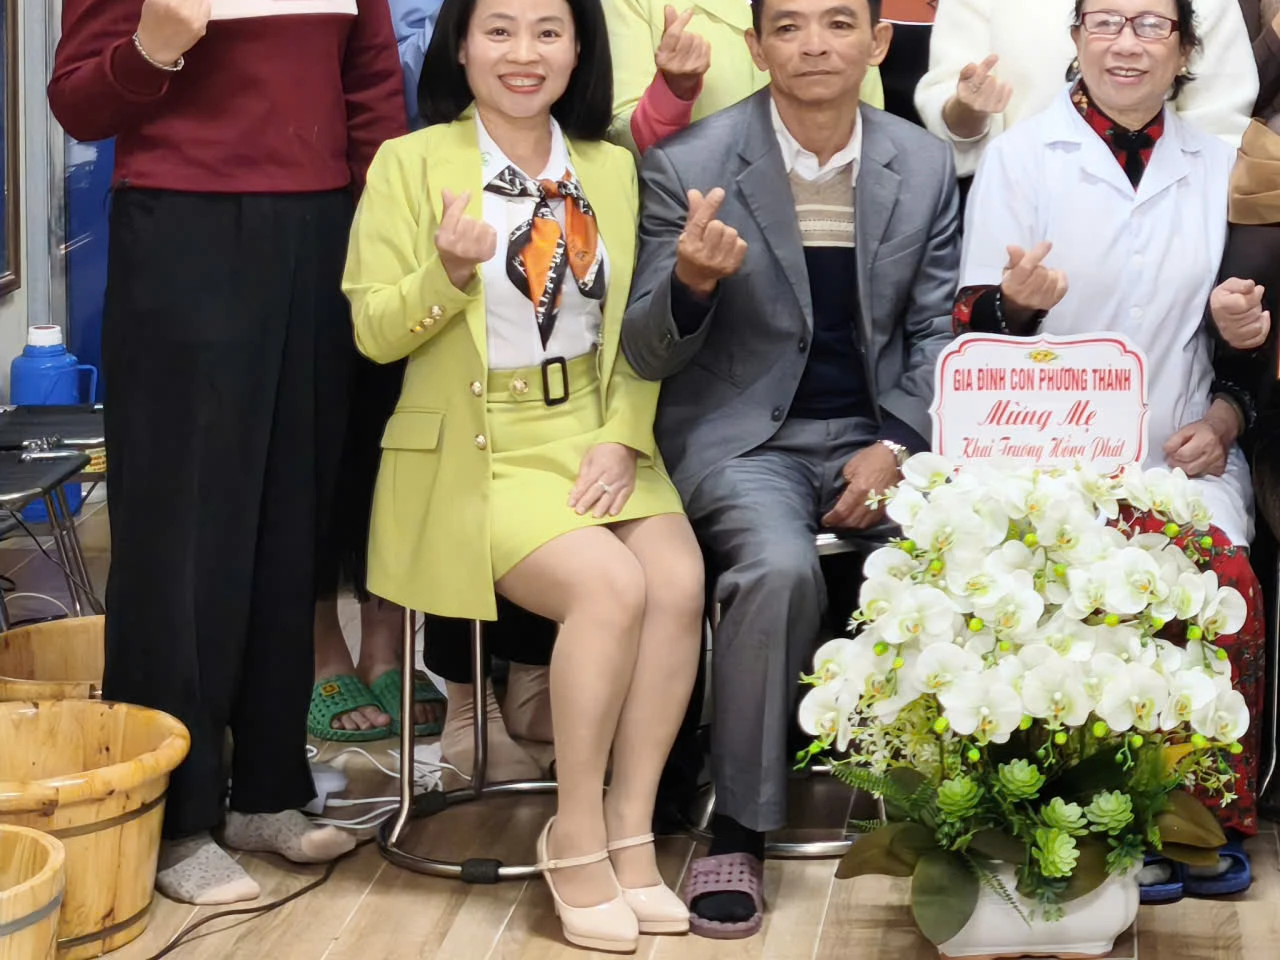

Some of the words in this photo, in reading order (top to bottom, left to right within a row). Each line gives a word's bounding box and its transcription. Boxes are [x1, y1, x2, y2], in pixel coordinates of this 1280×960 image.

[953, 368, 973, 391] GIA
[977, 363, 1006, 391] ĐÌNH
[1010, 368, 1035, 391] CON
[1039, 366, 1088, 391] PHƯƠNG
[977, 400, 1052, 432] Mừng
[1056, 400, 1097, 433] Mẹ
[962, 436, 994, 458] Khai
[1091, 437, 1126, 462] Phát
